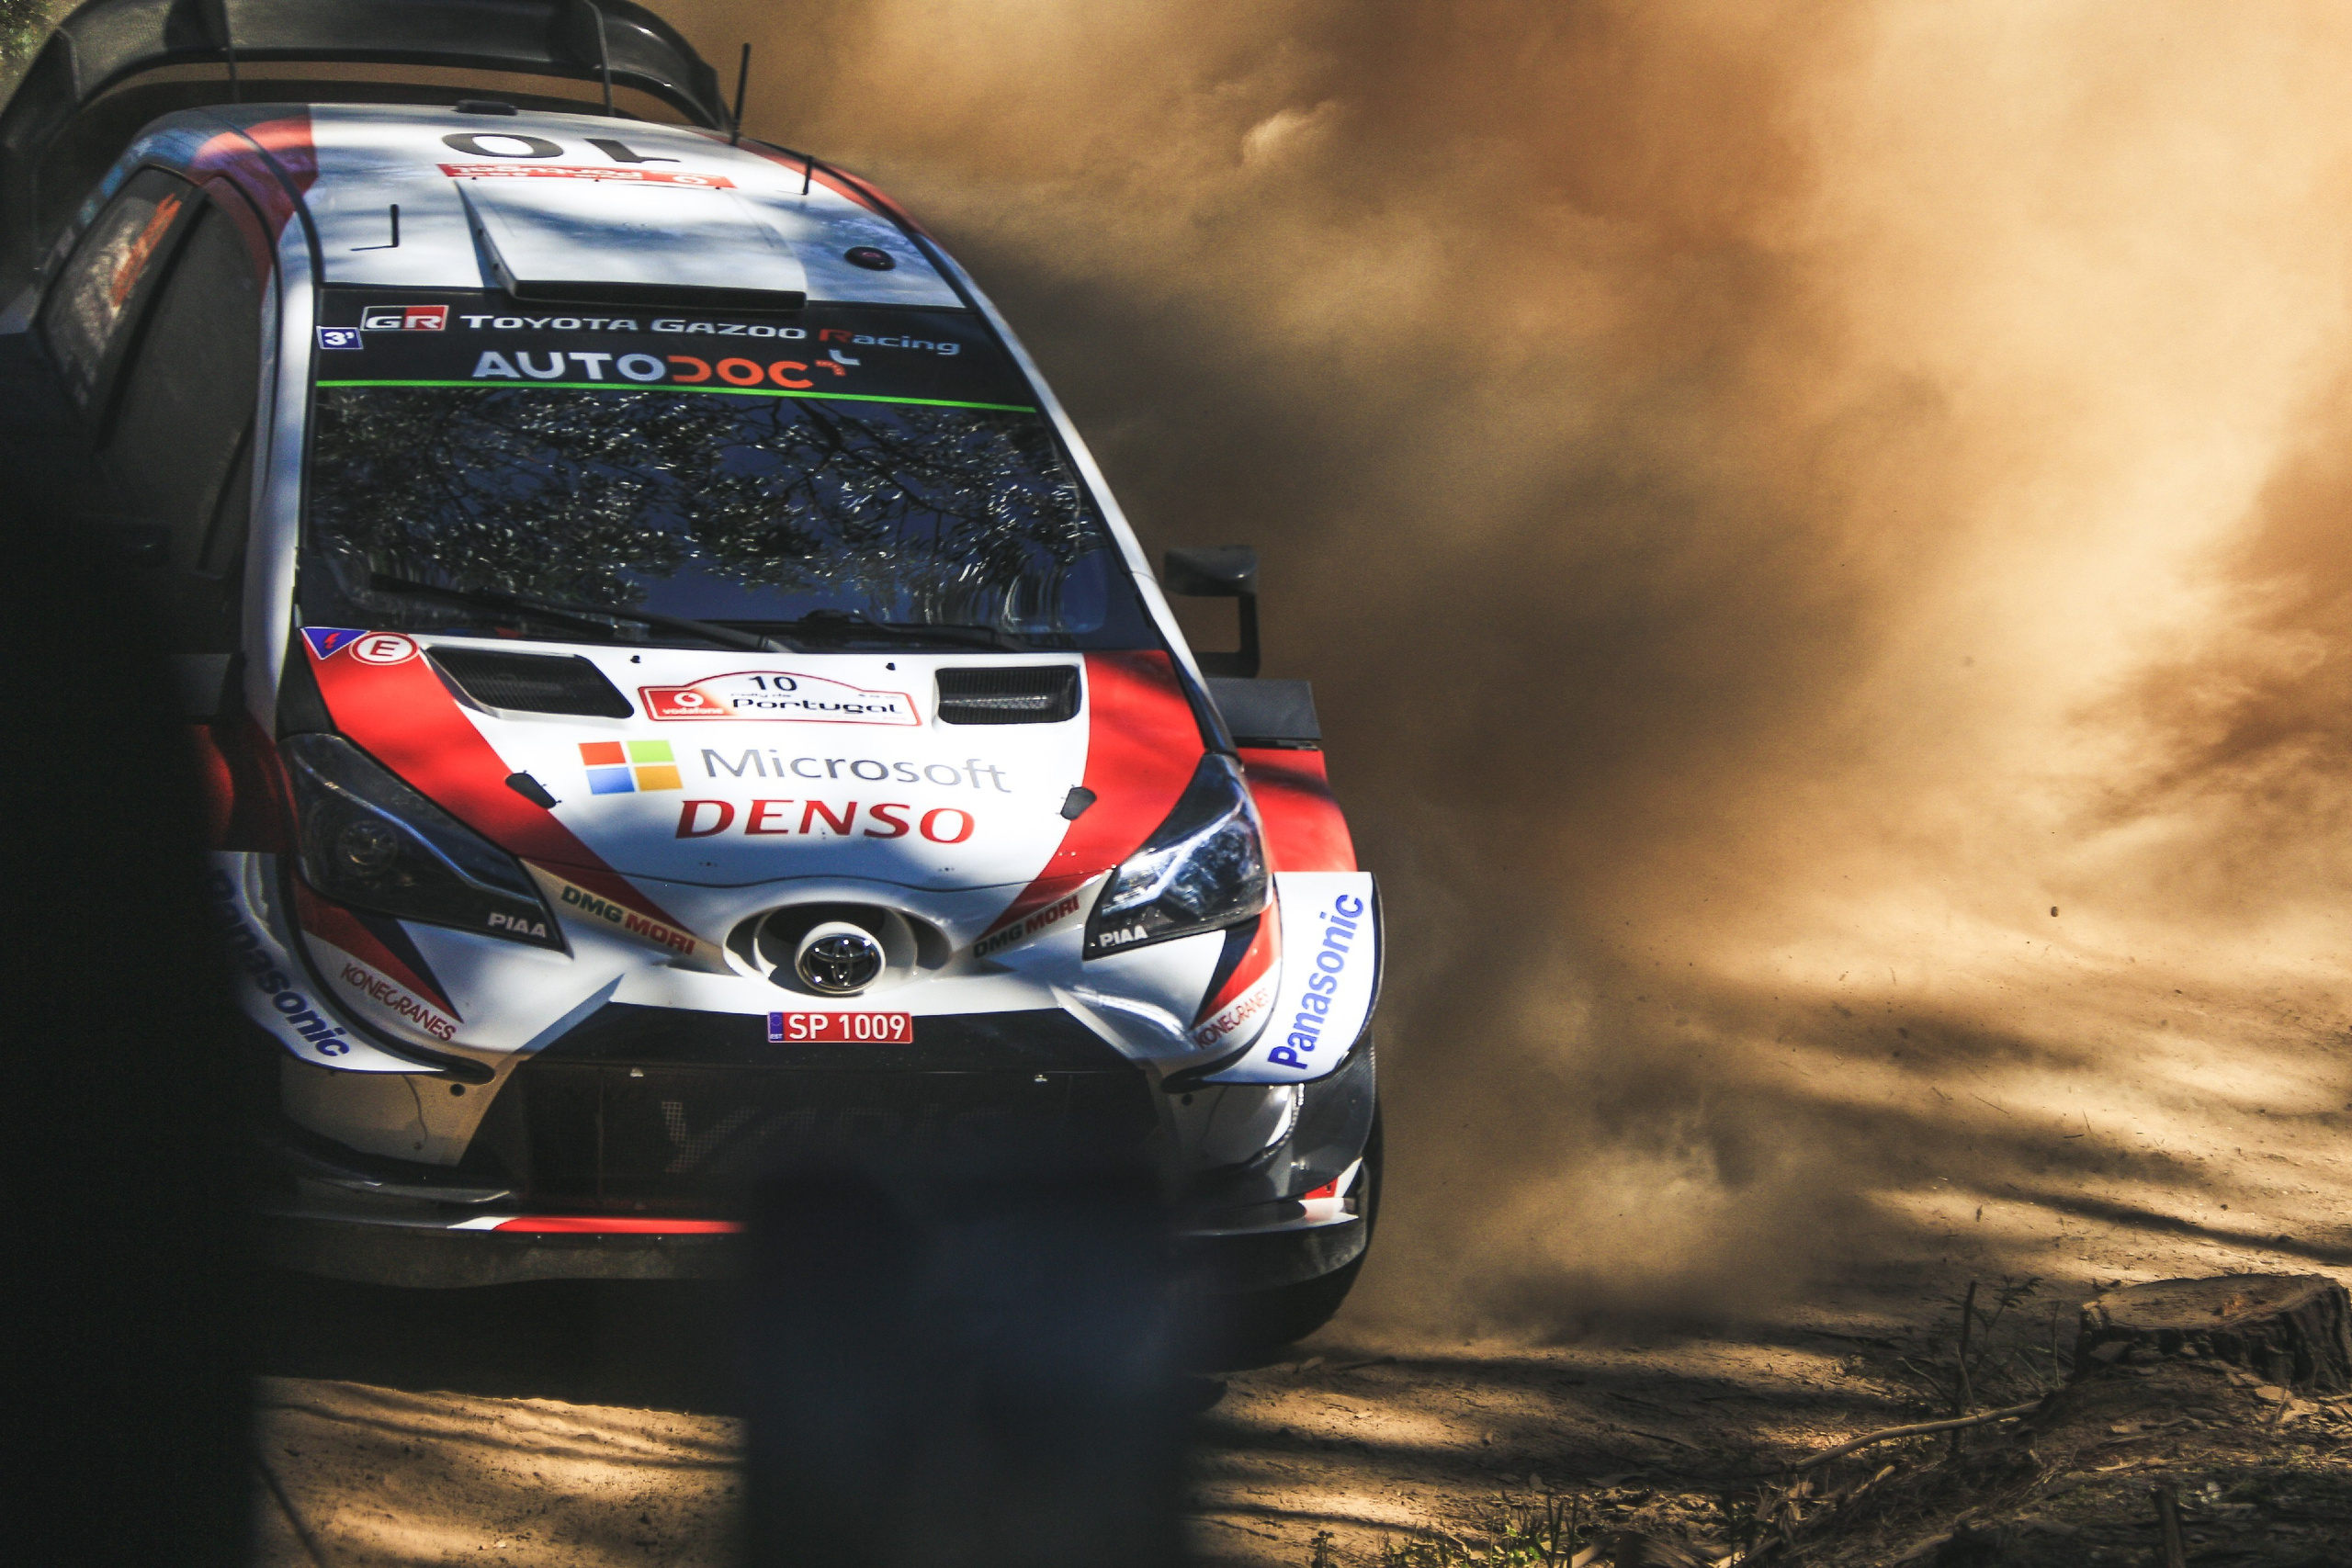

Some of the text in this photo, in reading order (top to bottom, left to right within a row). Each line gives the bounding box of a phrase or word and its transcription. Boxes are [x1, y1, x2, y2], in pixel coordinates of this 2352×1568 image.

[366, 314, 961, 355] GR TOYOTA GAZOO Racing
[472, 351, 814, 389] AUTODOC
[369, 639, 401, 657] E
[748, 675, 797, 691] 10
[662, 706, 724, 715] vodafone
[732, 698, 903, 714] Portugal
[700, 749, 1012, 793] Microsoft
[674, 798, 976, 843] DENSO
[487, 911, 547, 939] PIAA
[560, 886, 695, 955] DMG MORI
[973, 895, 1080, 959] DMG MORI
[1100, 925, 1148, 947] PIAA
[1268, 894, 1364, 1070] Panasonic
[341, 963, 458, 1042] KONECRANES
[1195, 987, 1271, 1050] KONECRANES
[788, 1013, 906, 1040] SP 1009
